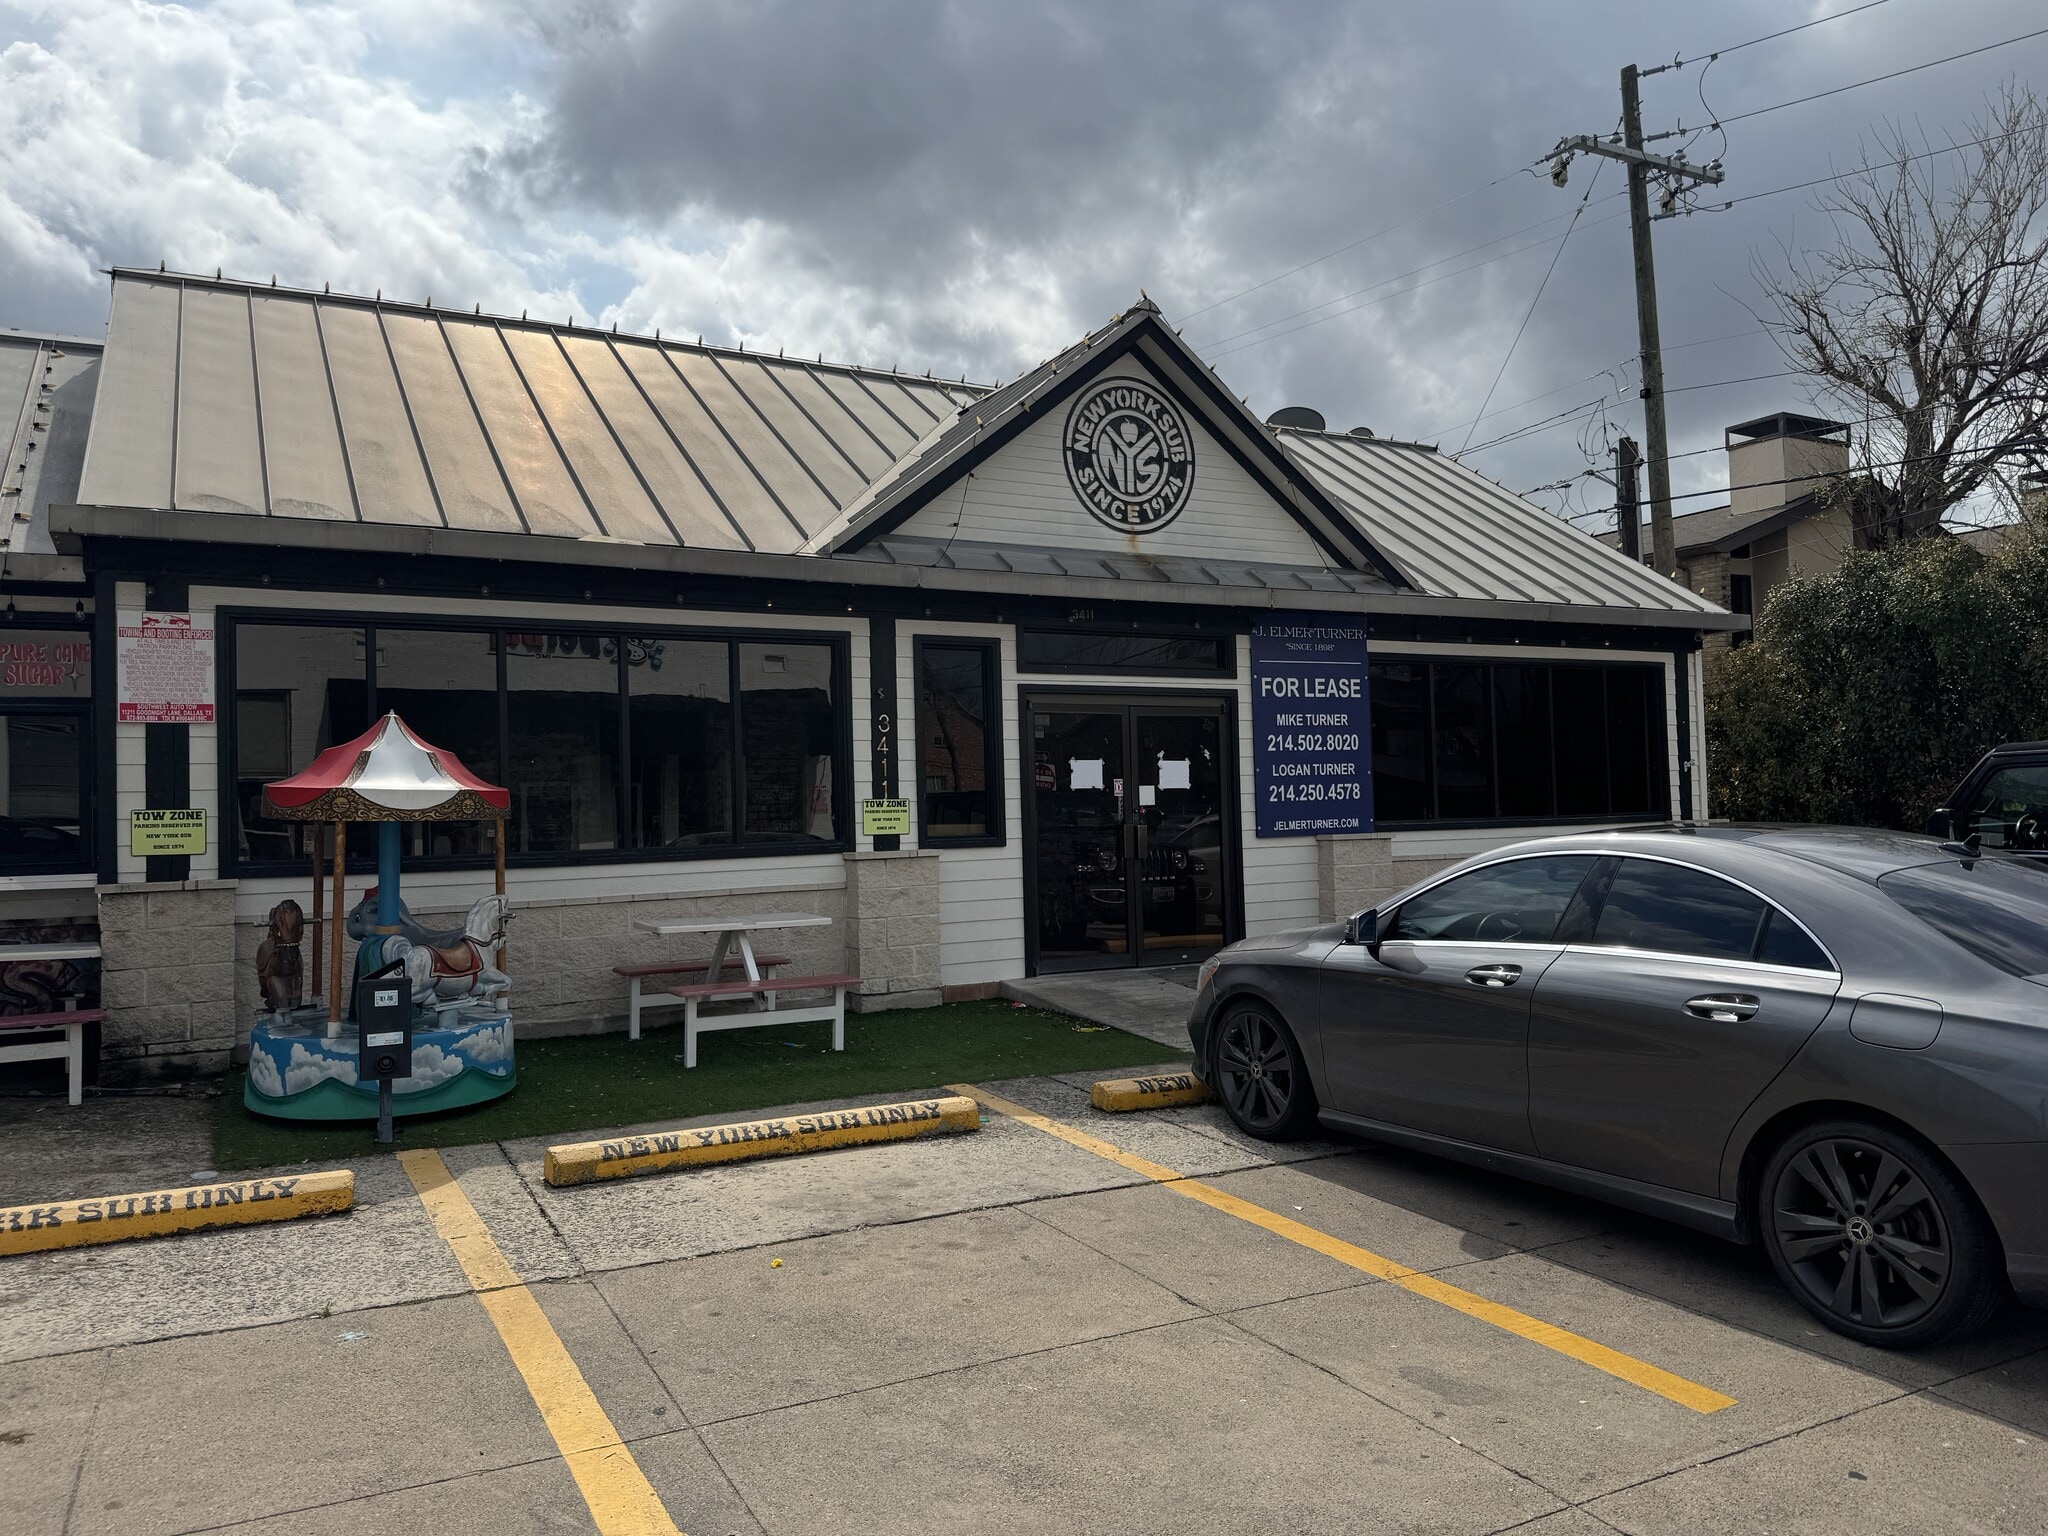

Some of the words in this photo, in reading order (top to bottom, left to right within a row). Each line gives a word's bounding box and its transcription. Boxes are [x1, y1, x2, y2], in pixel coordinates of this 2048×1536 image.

[1074, 396, 1106, 453] NEW
[1103, 388, 1162, 420] YORK
[1158, 414, 1185, 463] SUB
[1078, 467, 1140, 523] SINCE
[1142, 476, 1184, 520] 1974
[120, 628, 142, 637] TOWING
[144, 628, 156, 638] AND
[157, 629, 182, 638] BOOTING
[183, 630, 212, 640] ENFORCED
[1270, 626, 1312, 638] ELMER
[1314, 627, 1364, 640] TURNER
[0, 643, 48, 664] PURE
[4, 664, 66, 686] SUGAR
[1261, 677, 1300, 698] FOR
[1304, 678, 1362, 699] LEASE
[1276, 714, 1304, 726] MIKE
[1305, 714, 1348, 726] TURNER
[1267, 734, 1359, 752] 214.502.8020
[1272, 764, 1311, 777] LOGAN
[1312, 763, 1356, 776] TURNER
[1269, 783, 1361, 802] 214.250.4578
[134, 812, 166, 820] TOW
[170, 811, 203, 820] ZONE
[1274, 818, 1359, 831] JELMERTURNER.COM
[1134, 1076, 1192, 1094] NEW
[599, 1134, 680, 1162] NEW
[690, 1120, 791, 1148] YORK
[867, 1101, 941, 1126] ONLY
